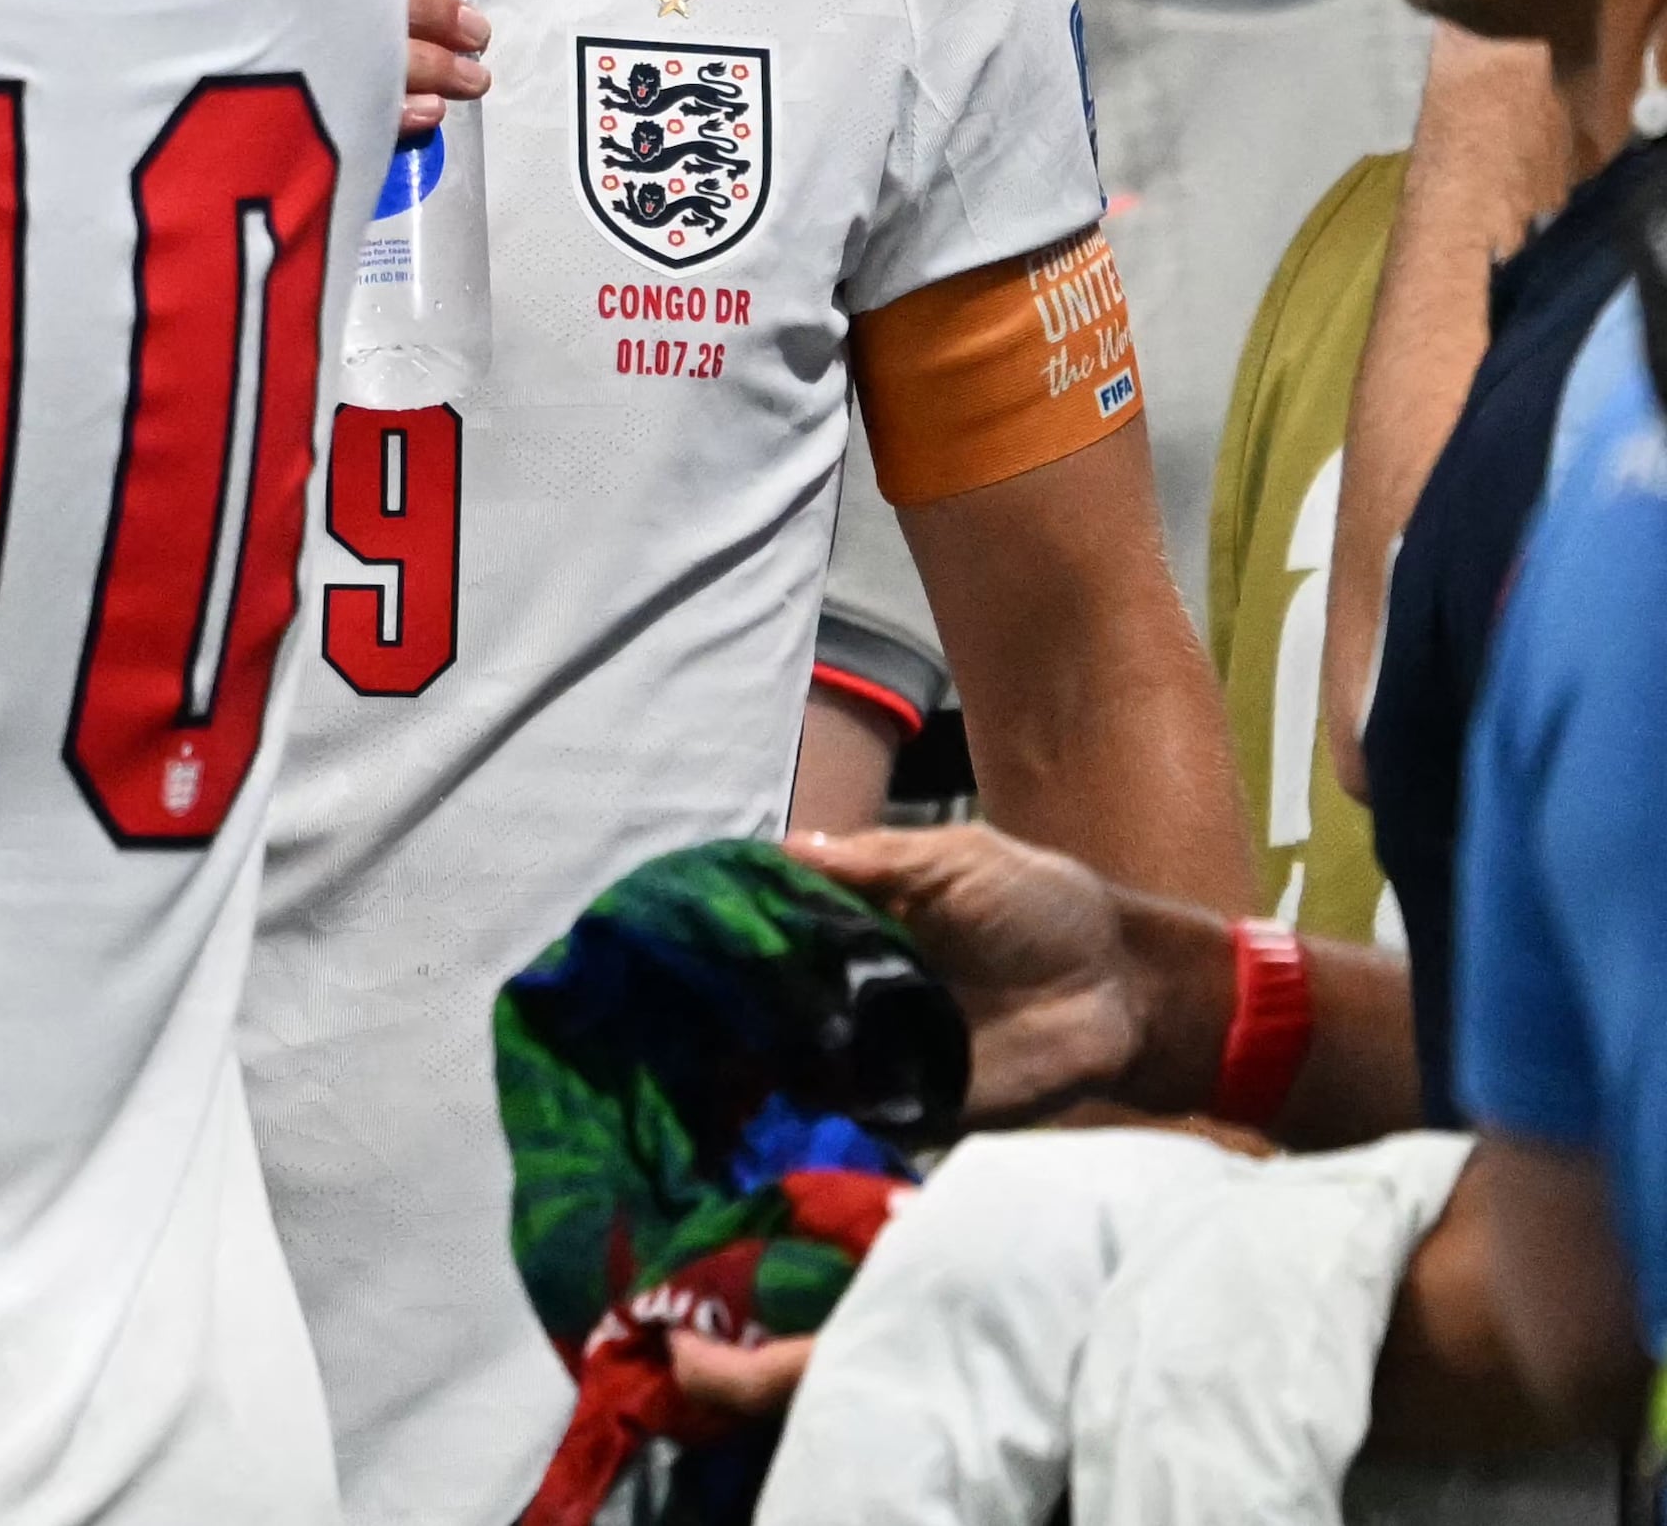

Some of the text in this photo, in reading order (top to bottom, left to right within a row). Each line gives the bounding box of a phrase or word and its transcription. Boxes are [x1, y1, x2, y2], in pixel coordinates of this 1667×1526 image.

[597, 283, 752, 326] CONGO DR
[1033, 246, 1125, 344] UNITE
[616, 338, 727, 379] 01.07.26
[1040, 344, 1095, 399] the
[1099, 374, 1134, 413] FIFA
[322, 401, 464, 698] 9
